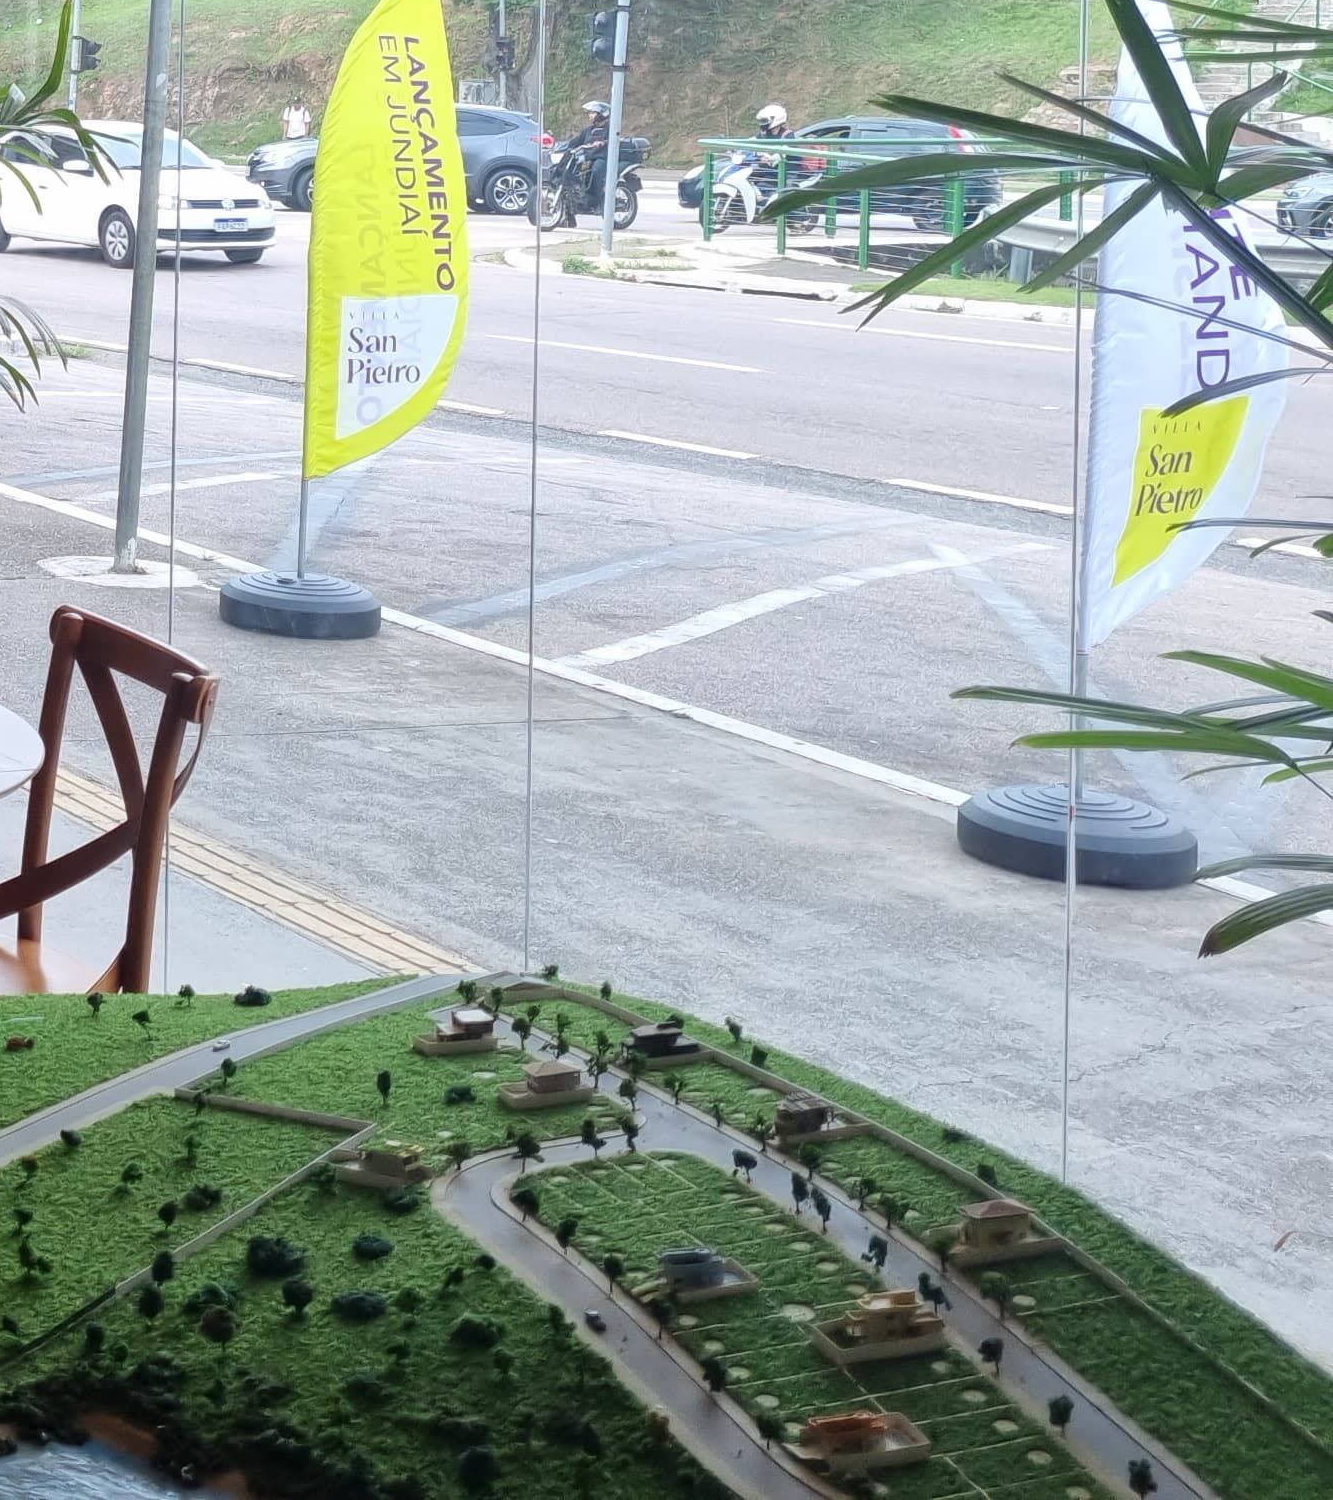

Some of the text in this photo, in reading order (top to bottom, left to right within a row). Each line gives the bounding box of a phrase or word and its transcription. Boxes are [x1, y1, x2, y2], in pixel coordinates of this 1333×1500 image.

[379, 35, 428, 237] EM JUNDIAÍ
[403, 36, 455, 291] LANÇAMENTO
[347, 326, 398, 353] San
[346, 358, 421, 384] Pietro
[1145, 443, 1193, 478] San
[1135, 481, 1204, 517] Pietro
